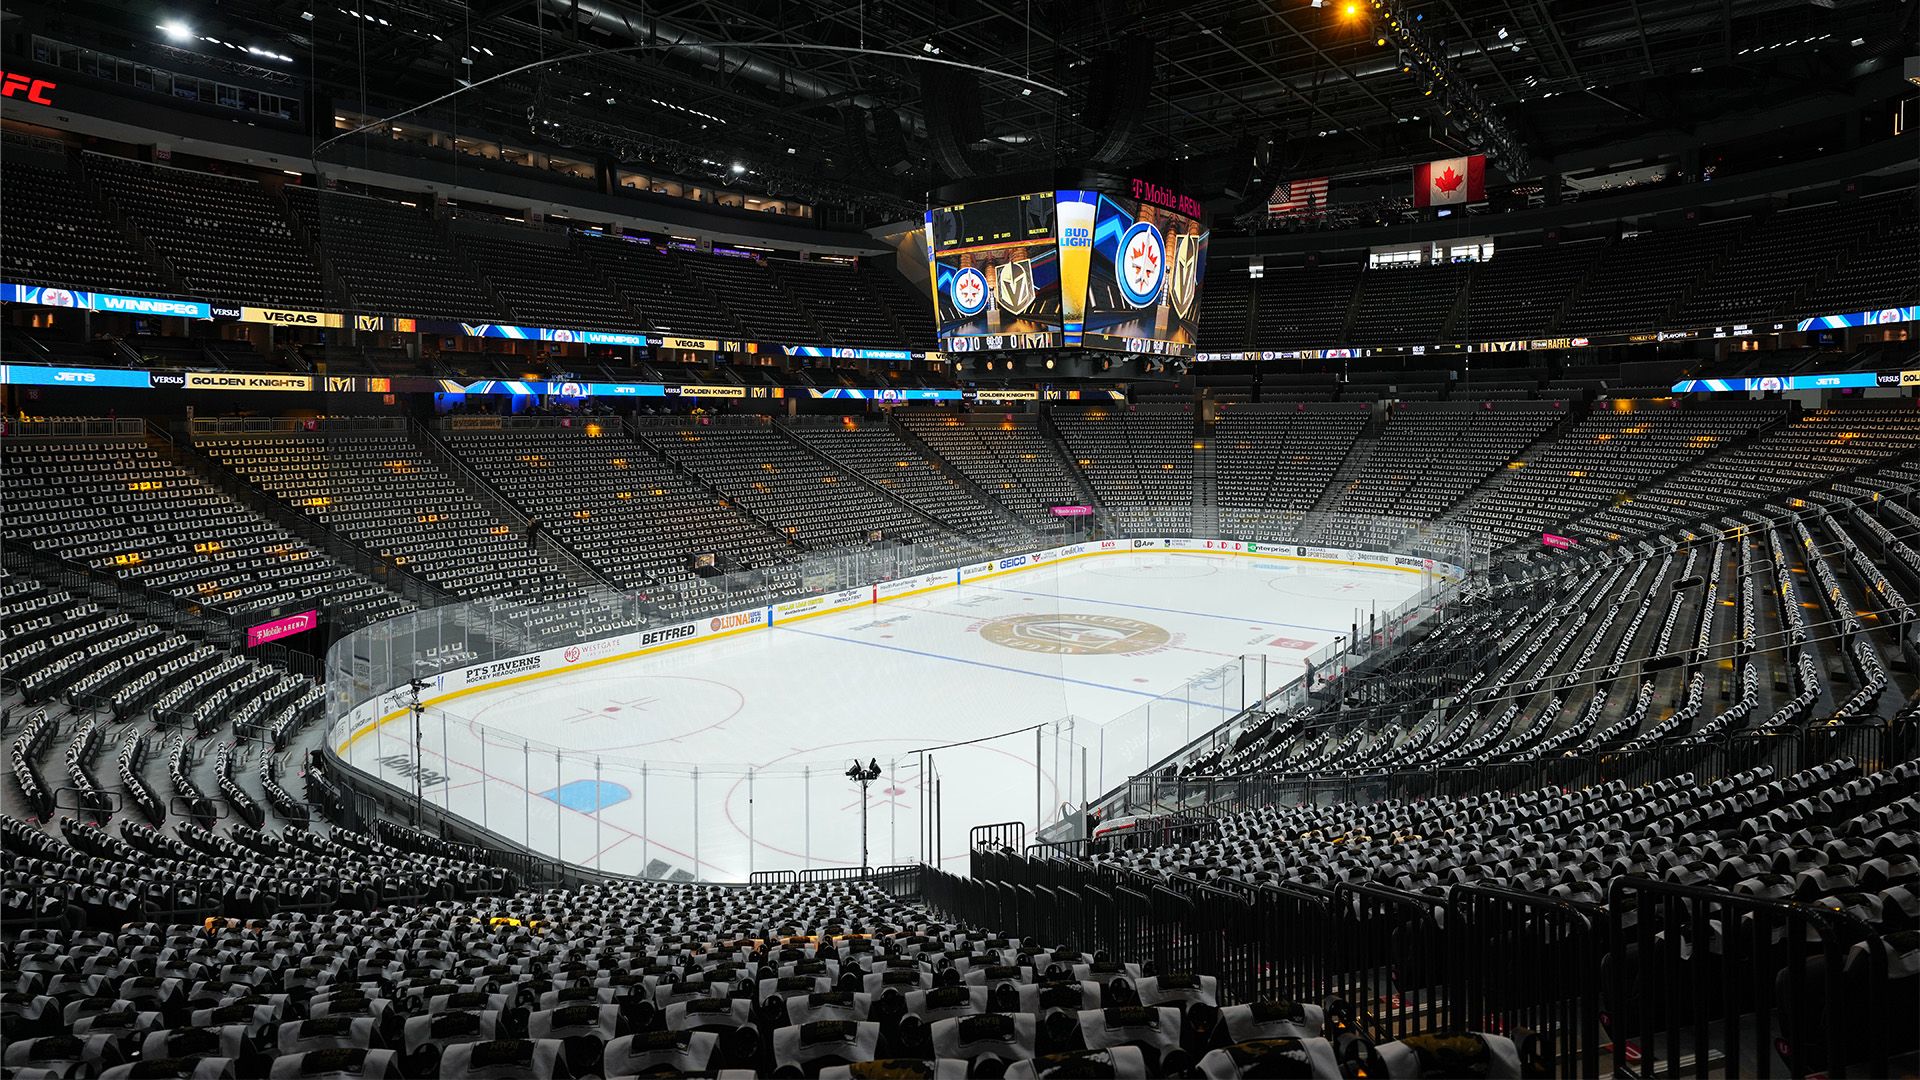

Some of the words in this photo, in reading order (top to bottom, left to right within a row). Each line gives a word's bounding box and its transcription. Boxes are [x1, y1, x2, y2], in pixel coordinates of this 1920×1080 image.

[1, 71, 56, 105] FC
[1145, 182, 1176, 208] Mobile
[1179, 194, 1201, 219] ARENA
[1065, 228, 1088, 237] BUD
[1060, 238, 1091, 247] LIGHT
[104, 297, 198, 315] WINNIPEG
[212, 307, 240, 317] VERSUS
[264, 311, 318, 324] VEGAS
[589, 334, 640, 345] WINNIPEG
[675, 339, 705, 348] VEGAS
[974, 336, 980, 350] 0
[1010, 334, 1017, 349] 0
[1548, 338, 1570, 349] RAFFLE
[54, 371, 96, 382] JETS
[152, 375, 184, 384] VERSUS
[191, 377, 246, 387] GOLDEN
[249, 378, 305, 388] KNIGHTS
[1816, 377, 1840, 385] JETS
[1878, 375, 1899, 383] VERSUS
[684, 387, 711, 395] GOLDEN
[1000, 556, 1027, 569] GEICO
[1394, 556, 1424, 569] guaranteed
[283, 621, 305, 632] ARENA
[642, 624, 695, 645] BETFRED
[581, 639, 620, 653] WESTGATE
[490, 655, 541, 673] TAVERNS
[466, 674, 491, 684] HOCKEY
[492, 663, 541, 678] HEADQUARTERS
